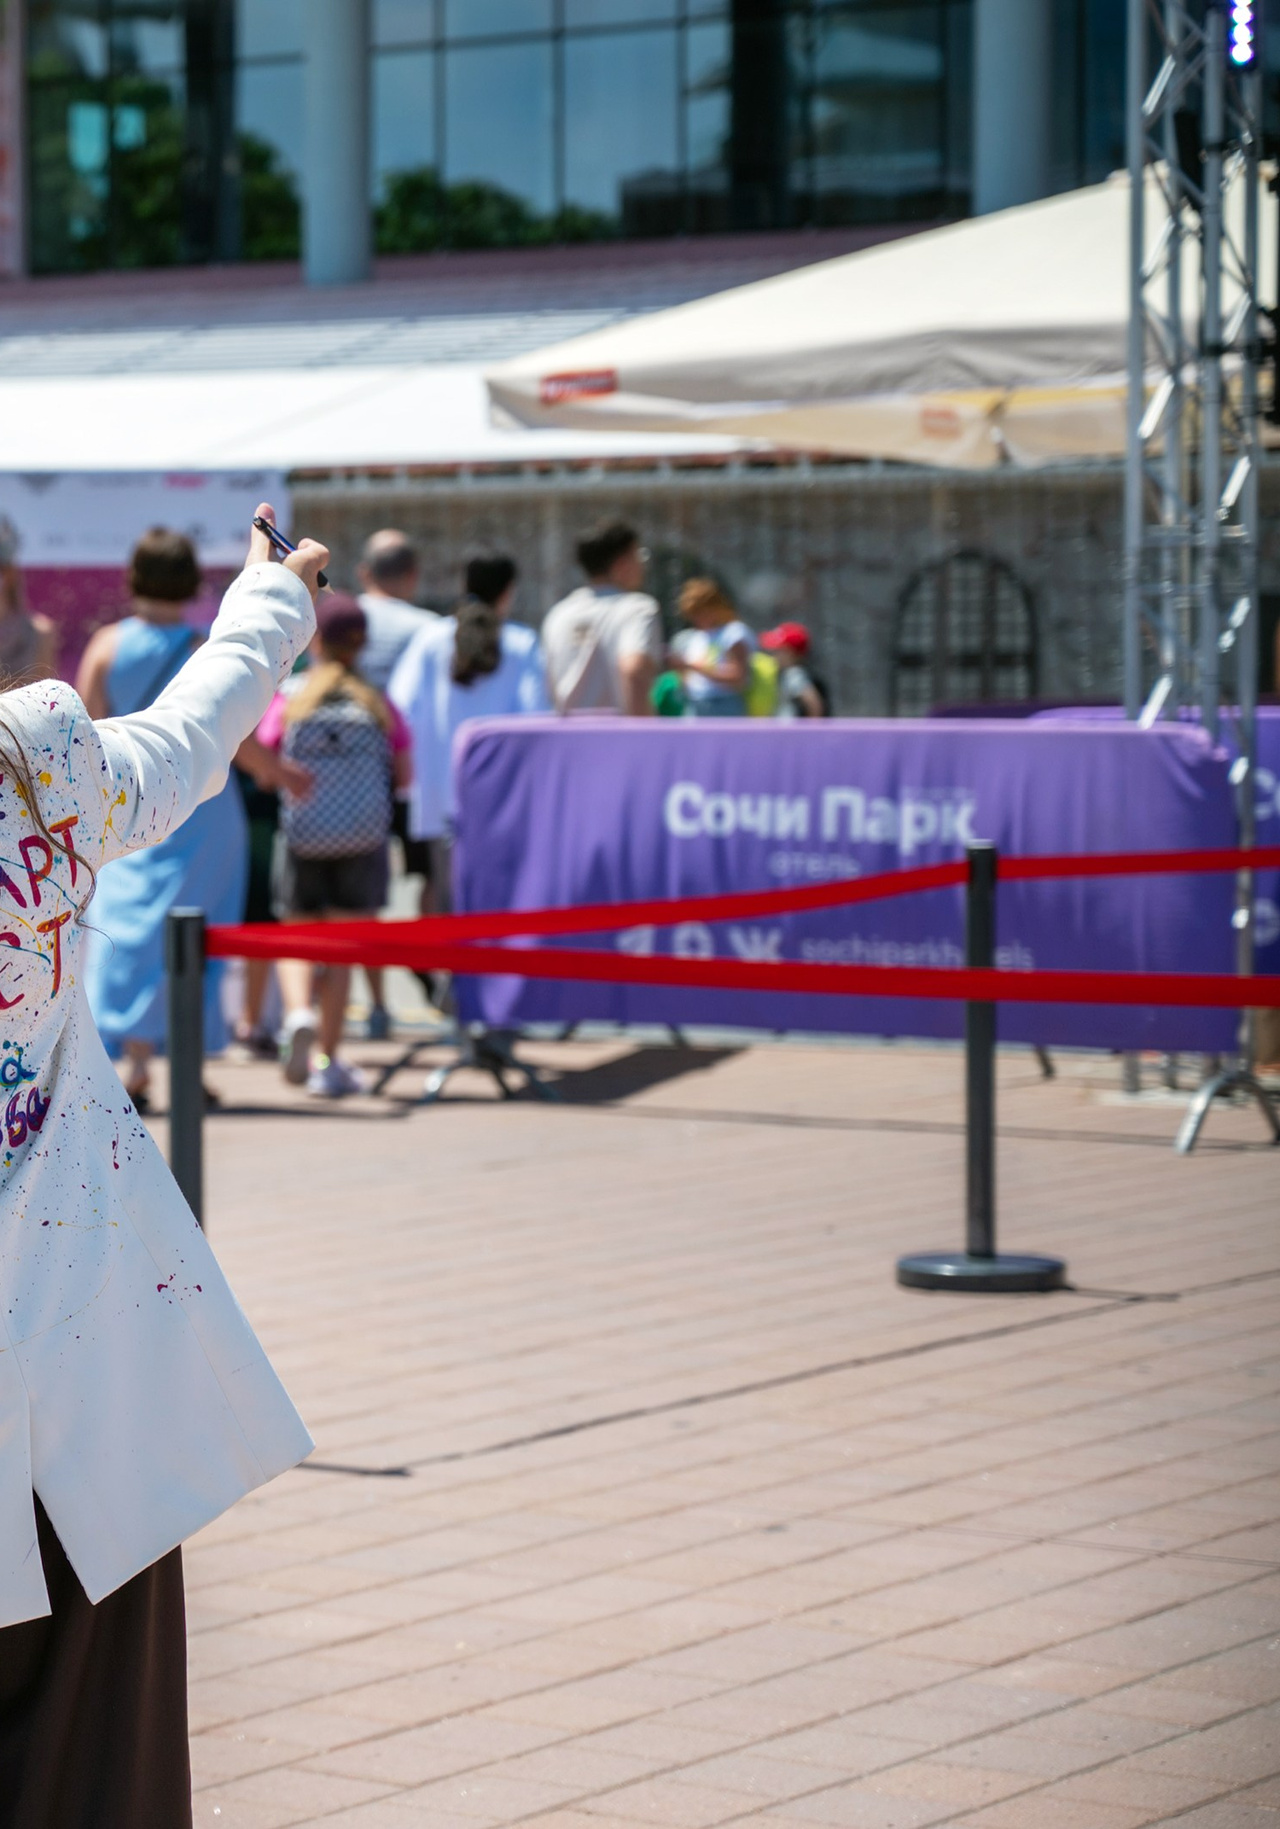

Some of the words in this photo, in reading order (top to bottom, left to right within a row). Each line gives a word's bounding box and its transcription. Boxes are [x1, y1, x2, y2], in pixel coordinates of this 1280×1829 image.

[665, 781, 809, 839] Сочи
[822, 785, 977, 856] Парк
[769, 852, 860, 879] отель
[800, 935, 1034, 971] sochiparkhels
